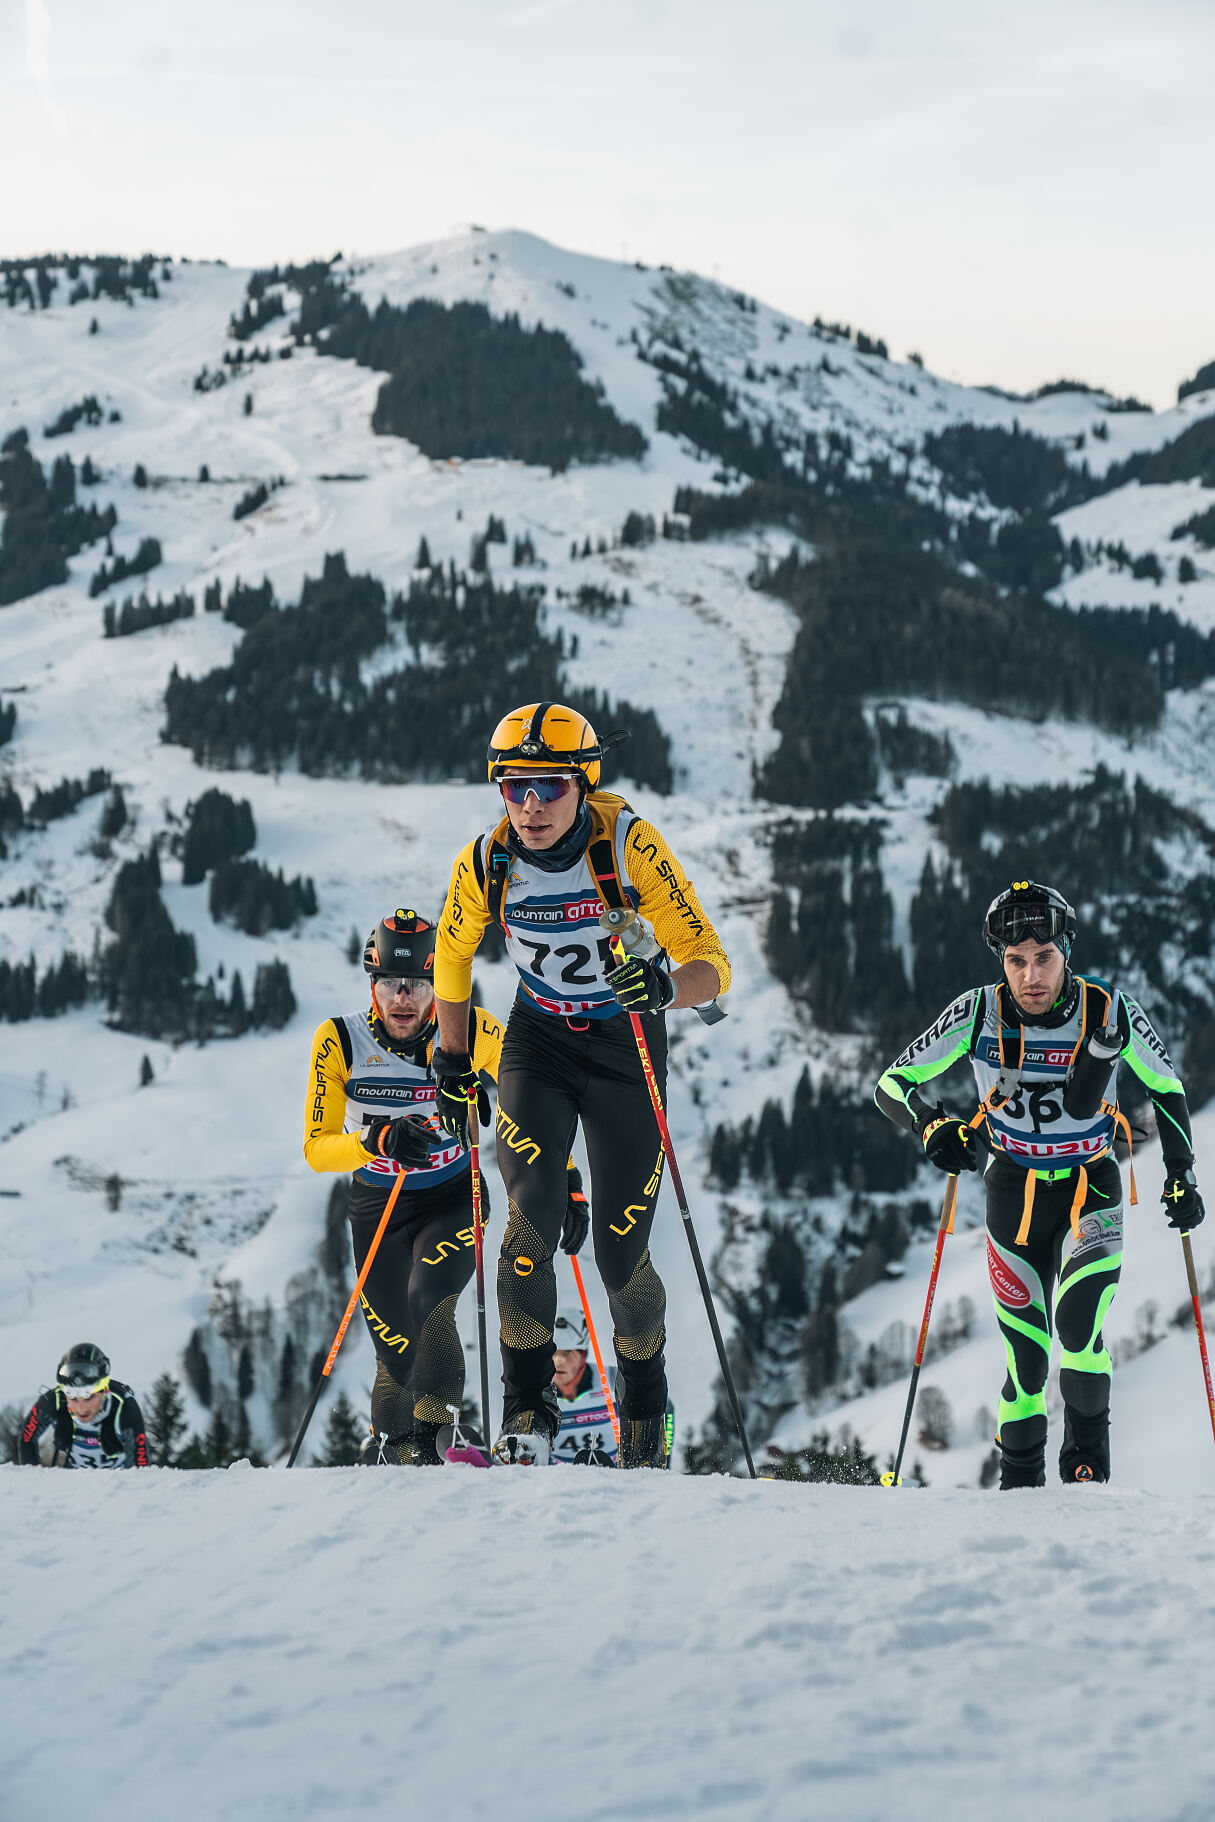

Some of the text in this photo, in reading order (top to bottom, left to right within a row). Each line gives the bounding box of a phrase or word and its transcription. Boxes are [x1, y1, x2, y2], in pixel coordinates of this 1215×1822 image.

[632, 832, 658, 863] LA
[483, 1020, 500, 1040] LA
[635, 1037, 652, 1073] LEKI
[312, 1036, 338, 1123] SPORTIVA
[357, 1087, 413, 1099] mountain
[1000, 1133, 1104, 1157] ISUZU
[609, 1204, 648, 1236] LA
[421, 1241, 461, 1266] LA
[995, 1270, 1026, 1298] Center
